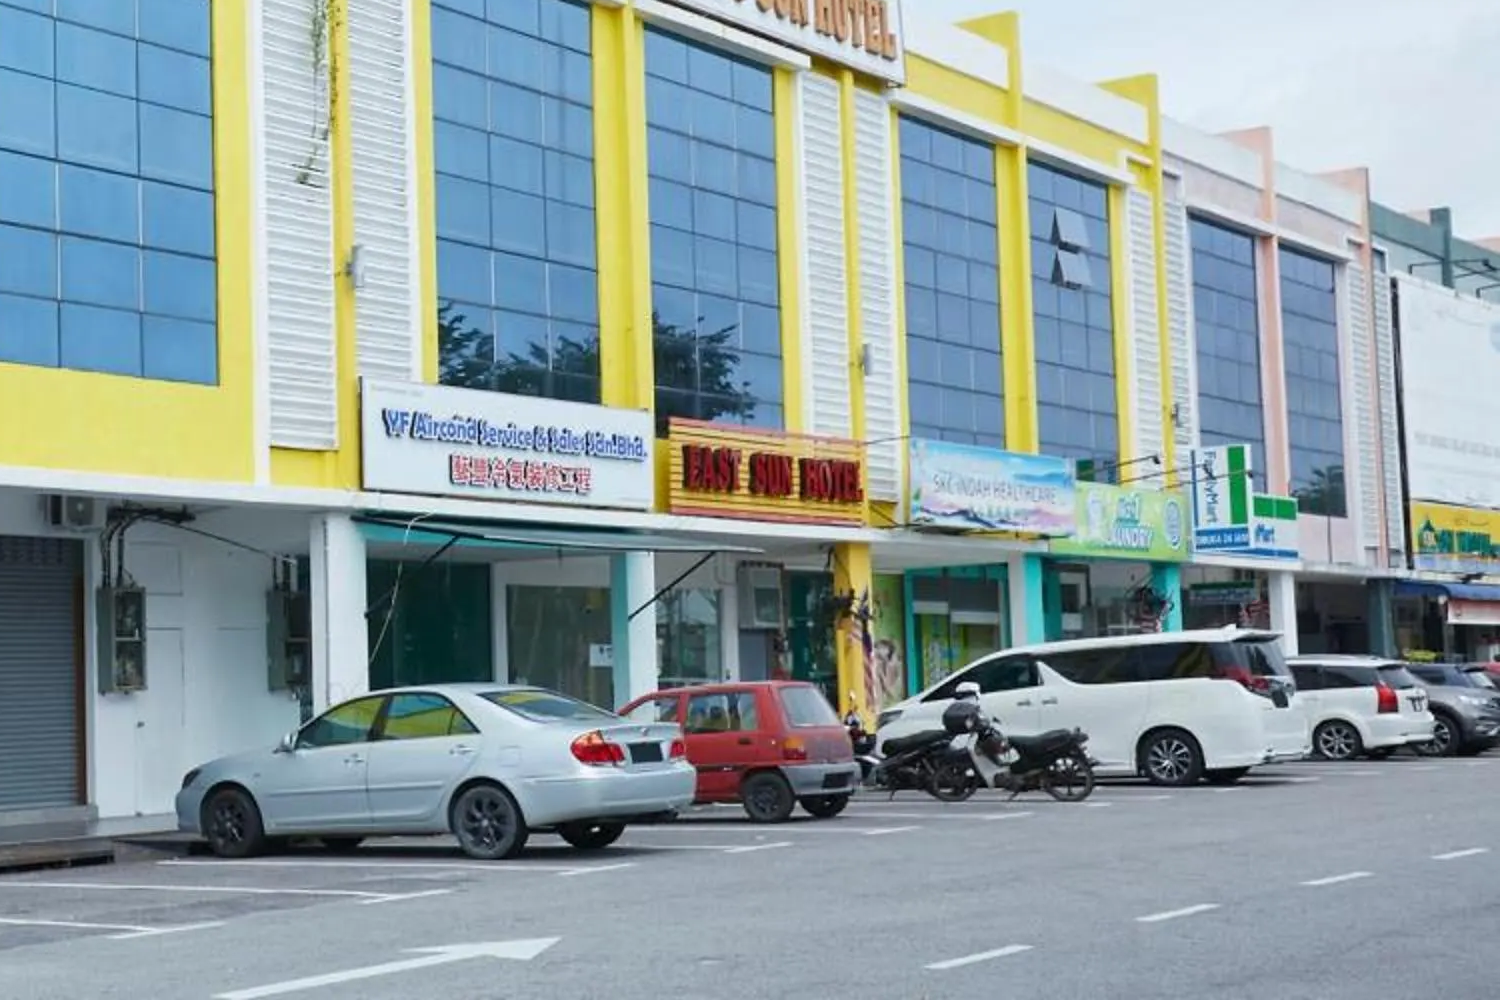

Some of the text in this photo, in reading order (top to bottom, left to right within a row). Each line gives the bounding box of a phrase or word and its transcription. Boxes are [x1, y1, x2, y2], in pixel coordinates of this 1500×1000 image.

[413, 411, 478, 444] Aircond
[479, 420, 534, 449] Service
[534, 427, 548, 451] &
[549, 428, 586, 454] Sales
[683, 441, 864, 503] EAST SUN HOTEL
